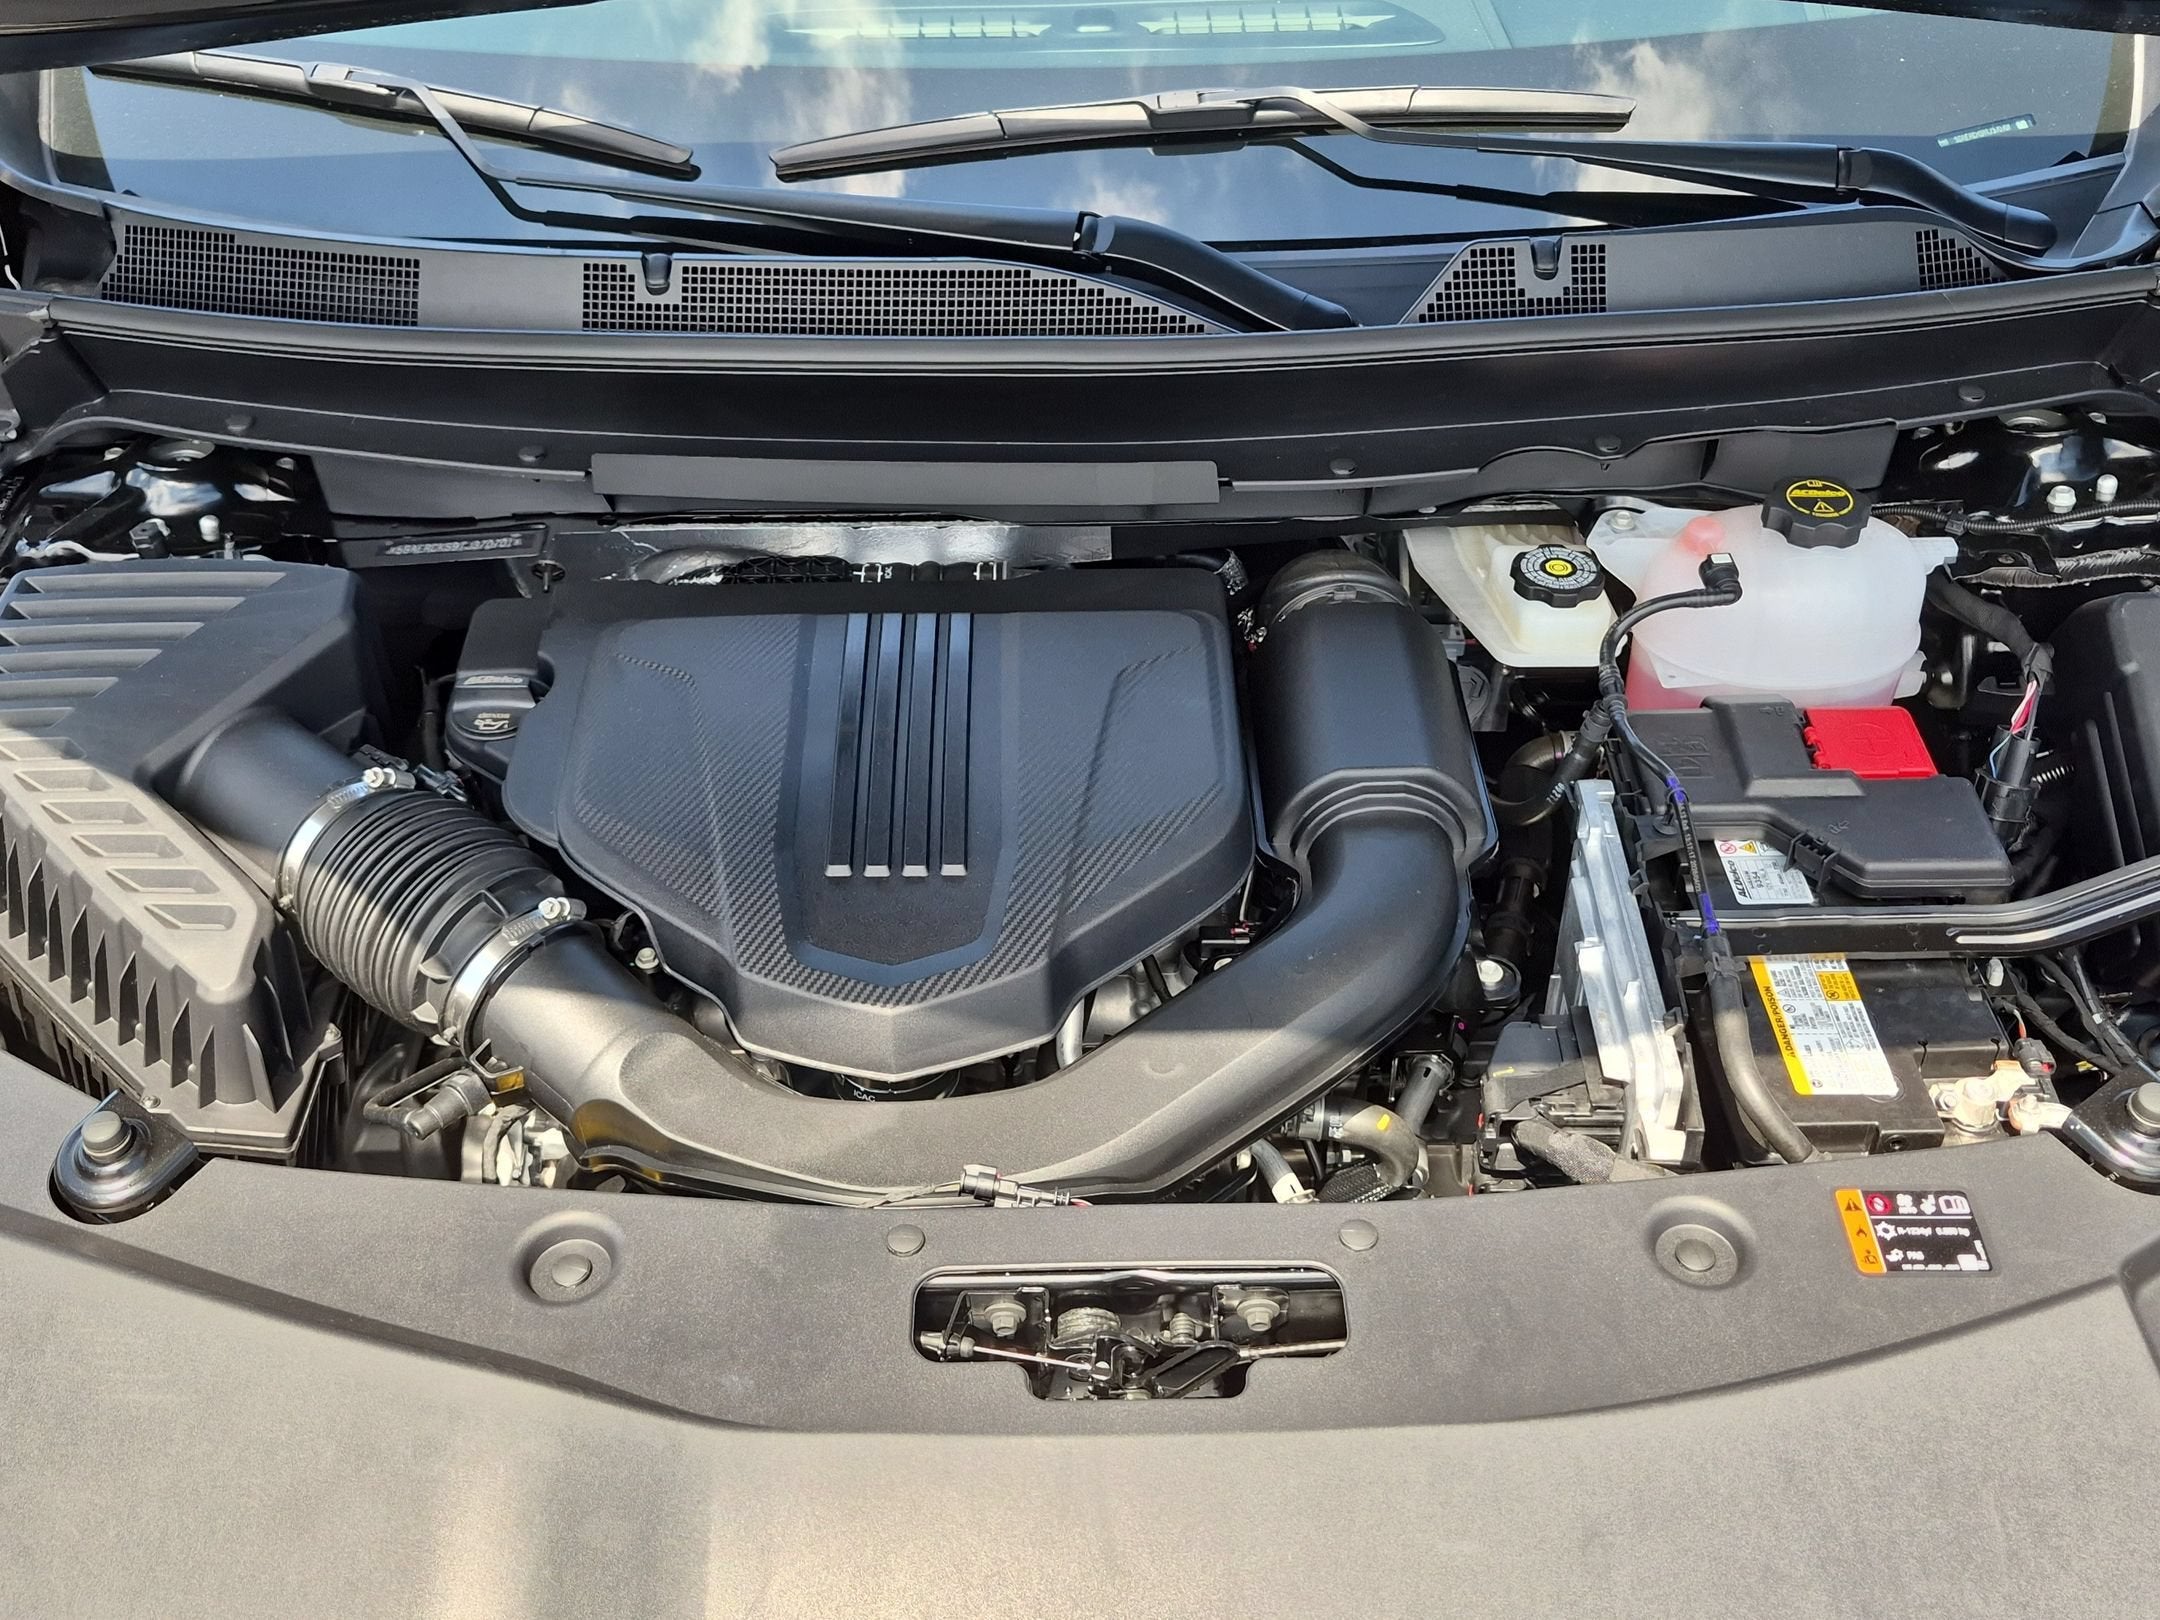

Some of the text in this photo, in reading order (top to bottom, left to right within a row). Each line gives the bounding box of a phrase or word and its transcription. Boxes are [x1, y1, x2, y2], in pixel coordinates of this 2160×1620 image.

[1790, 488, 1846, 498] ACDelco
[463, 674, 524, 685] ACDelco
[1726, 859, 1749, 898] ACDelco
[1762, 985, 1794, 1052] DANGER/POISON
